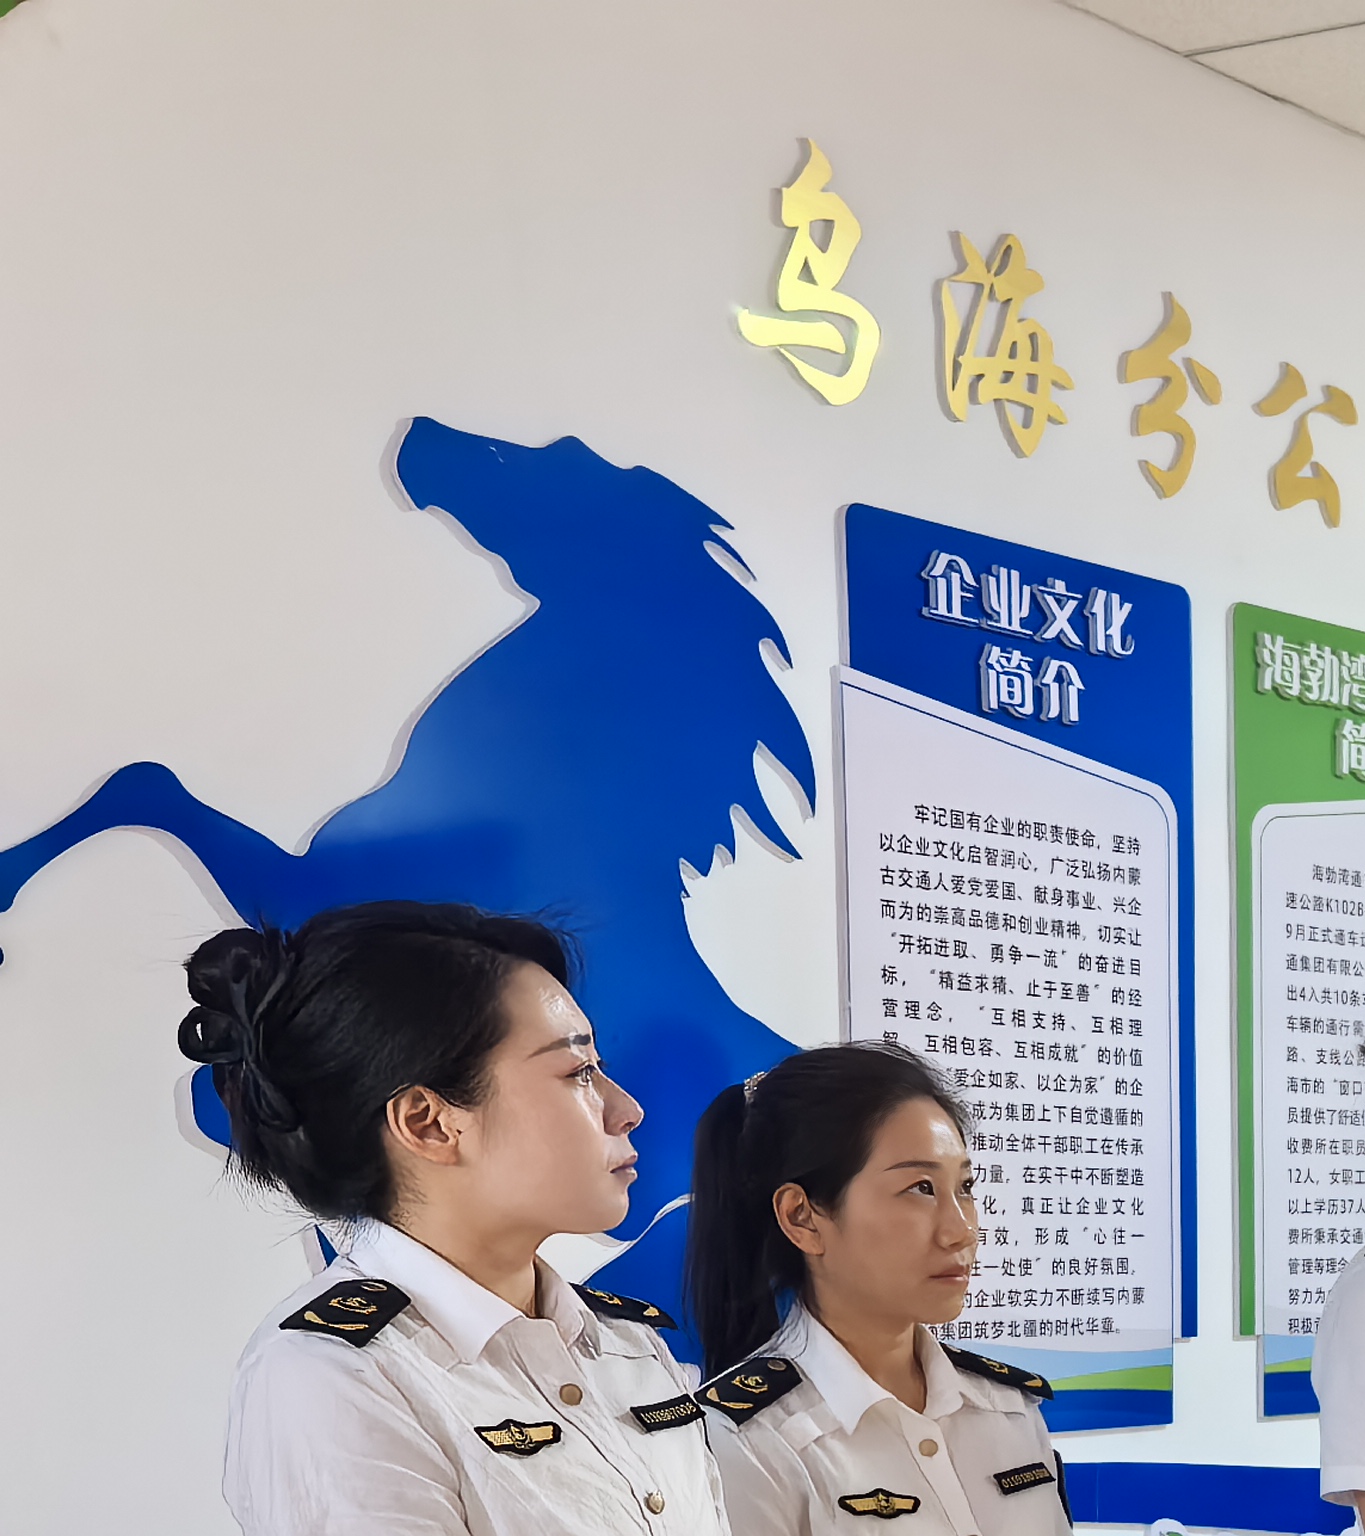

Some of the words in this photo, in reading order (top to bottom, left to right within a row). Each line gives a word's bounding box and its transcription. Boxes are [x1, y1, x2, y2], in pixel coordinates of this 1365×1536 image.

[922, 550, 1135, 657] 企业文化
[980, 643, 1085, 725] 简介
